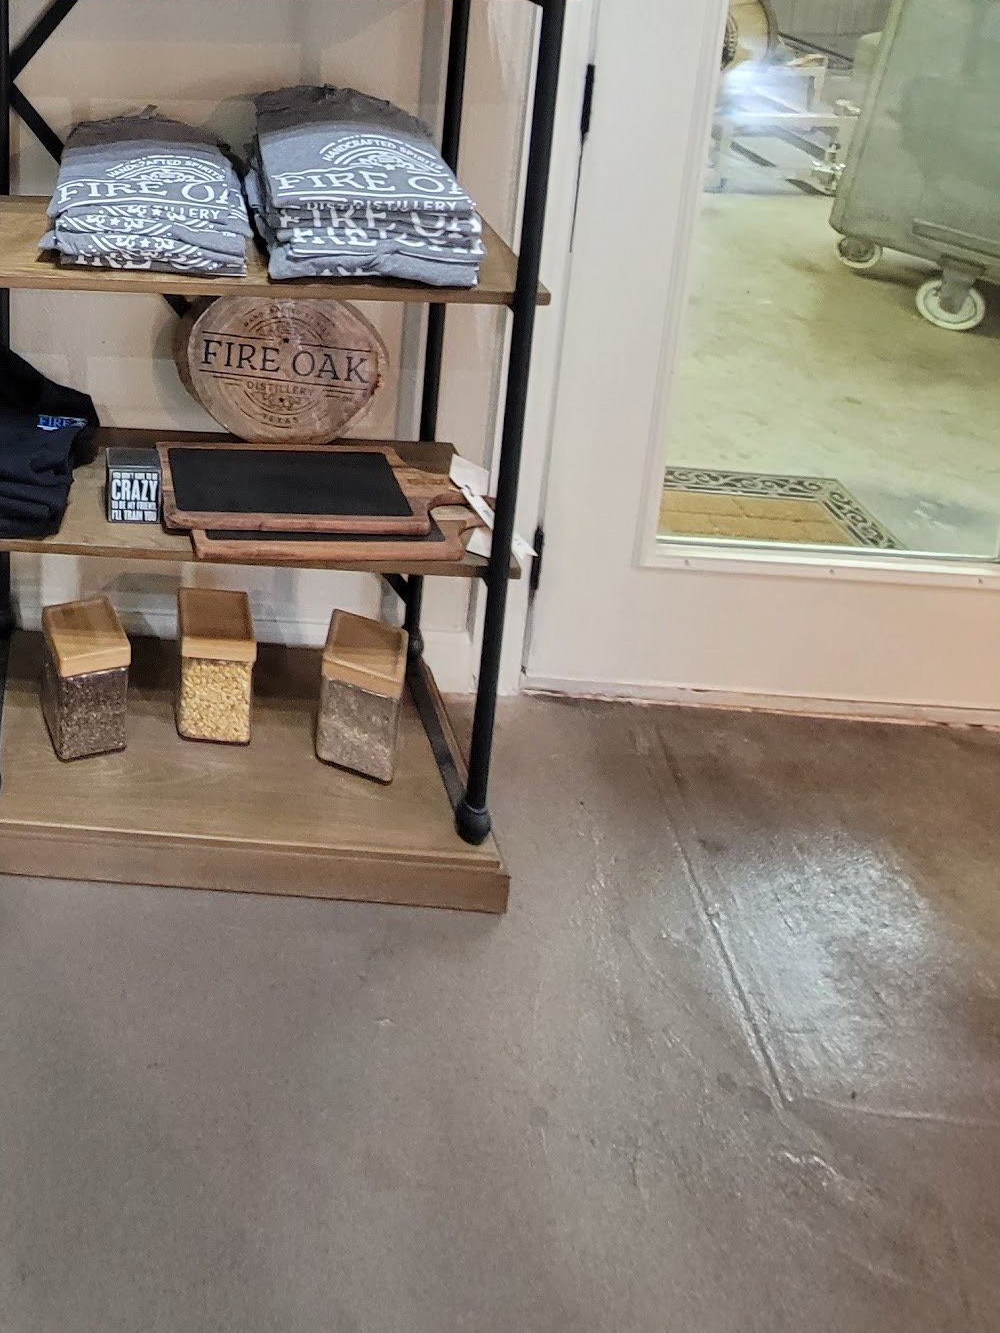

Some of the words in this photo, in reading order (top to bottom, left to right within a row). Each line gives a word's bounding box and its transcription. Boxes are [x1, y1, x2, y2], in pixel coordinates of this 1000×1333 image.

[323, 138, 397, 162] HANDCRAFTED
[399, 146, 444, 170] SPIRITS
[107, 158, 183, 178] HANDCRAFTED
[185, 160, 226, 181] SPIRITS
[276, 170, 396, 192] FIRE
[57, 180, 168, 205] FIRE
[181, 181, 229, 204] OA
[201, 339, 280, 373] FIRE
[292, 350, 369, 384] OAK
[247, 381, 314, 396] DISTILLERY
[40, 416, 70, 427] FIRE
[262, 414, 300, 424] TEXAS
[111, 479, 158, 501] CRAZY
